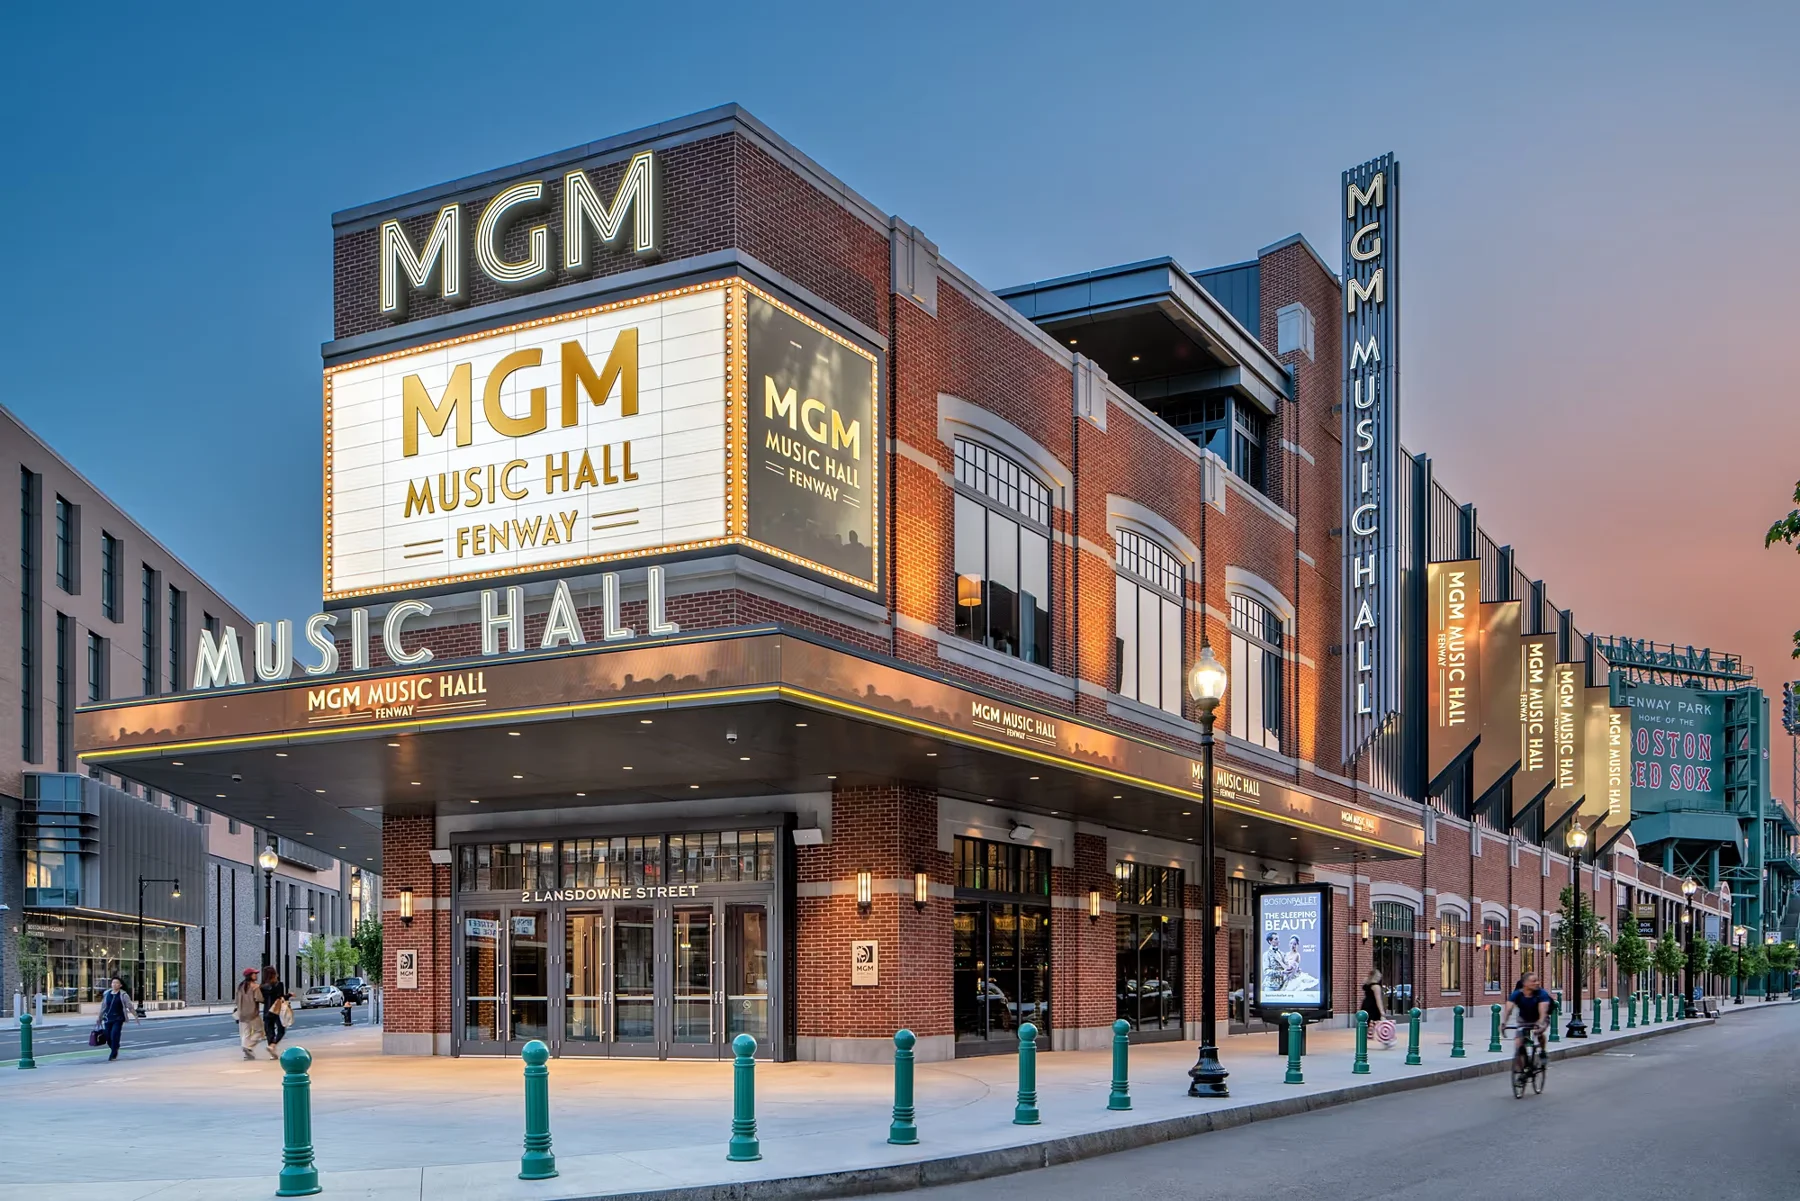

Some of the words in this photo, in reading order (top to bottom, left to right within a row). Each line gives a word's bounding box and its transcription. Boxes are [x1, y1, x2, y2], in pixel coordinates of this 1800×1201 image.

[380, 149, 660, 316] MGM
[1347, 172, 1384, 314] MGM
[402, 327, 639, 458] MGM
[765, 375, 860, 461] MGM
[1350, 334, 1381, 537] MUSIC
[765, 429, 820, 471] MUSIC
[825, 455, 860, 489] HALL
[403, 458, 529, 518] MUSIC
[545, 440, 639, 494] HALL
[789, 467, 839, 502] FENWAY
[456, 510, 578, 558] FENWAY
[1448, 571, 1465, 620] MGM
[193, 599, 434, 690] MUSIC
[480, 565, 680, 656] HALL
[1353, 553, 1377, 715] HALL
[1438, 633, 1446, 667] FENWAY
[1448, 626, 1466, 682] MUSIC
[1529, 643, 1544, 683] MGM
[308, 685, 360, 711] MGM
[367, 677, 433, 705] MUSIC
[439, 671, 487, 698] HALL
[1448, 687, 1466, 727] HALL
[1560, 671, 1574, 708] MGM
[1619, 695, 1671, 711] FENWAY
[1678, 701, 1712, 716] PARK
[375, 704, 414, 719] FENWAY
[972, 701, 1000, 724] MGM
[1003, 711, 1034, 733] MUSIC
[1036, 720, 1056, 739] HALL
[1520, 694, 1528, 723] FENWAY
[1529, 687, 1544, 735] MUSIC
[1638, 714, 1661, 723] HOME
[1679, 718, 1694, 727] THE
[1006, 728, 1026, 740] FENWAY
[1560, 712, 1574, 755] MUSIC
[1609, 713, 1621, 746] MGM
[1630, 727, 1712, 761] OSTON
[1529, 738, 1544, 772] HALL
[1560, 758, 1574, 789] HALL
[1609, 748, 1621, 787] MUSIC
[1216, 770, 1242, 791] MUSIC
[1243, 778, 1260, 797] HALL
[1219, 788, 1235, 800] FENWAY
[1630, 761, 1662, 789] ED
[1669, 763, 1712, 792] SOX
[1609, 789, 1621, 815] HALL
[521, 891, 530, 903] 2
[534, 887, 632, 902] LANSDOWNE
[636, 885, 699, 898] STREET
[1264, 912, 1280, 920] THE
[1280, 910, 1317, 919] SLEEPING
[1265, 918, 1317, 931] BEAUTY
